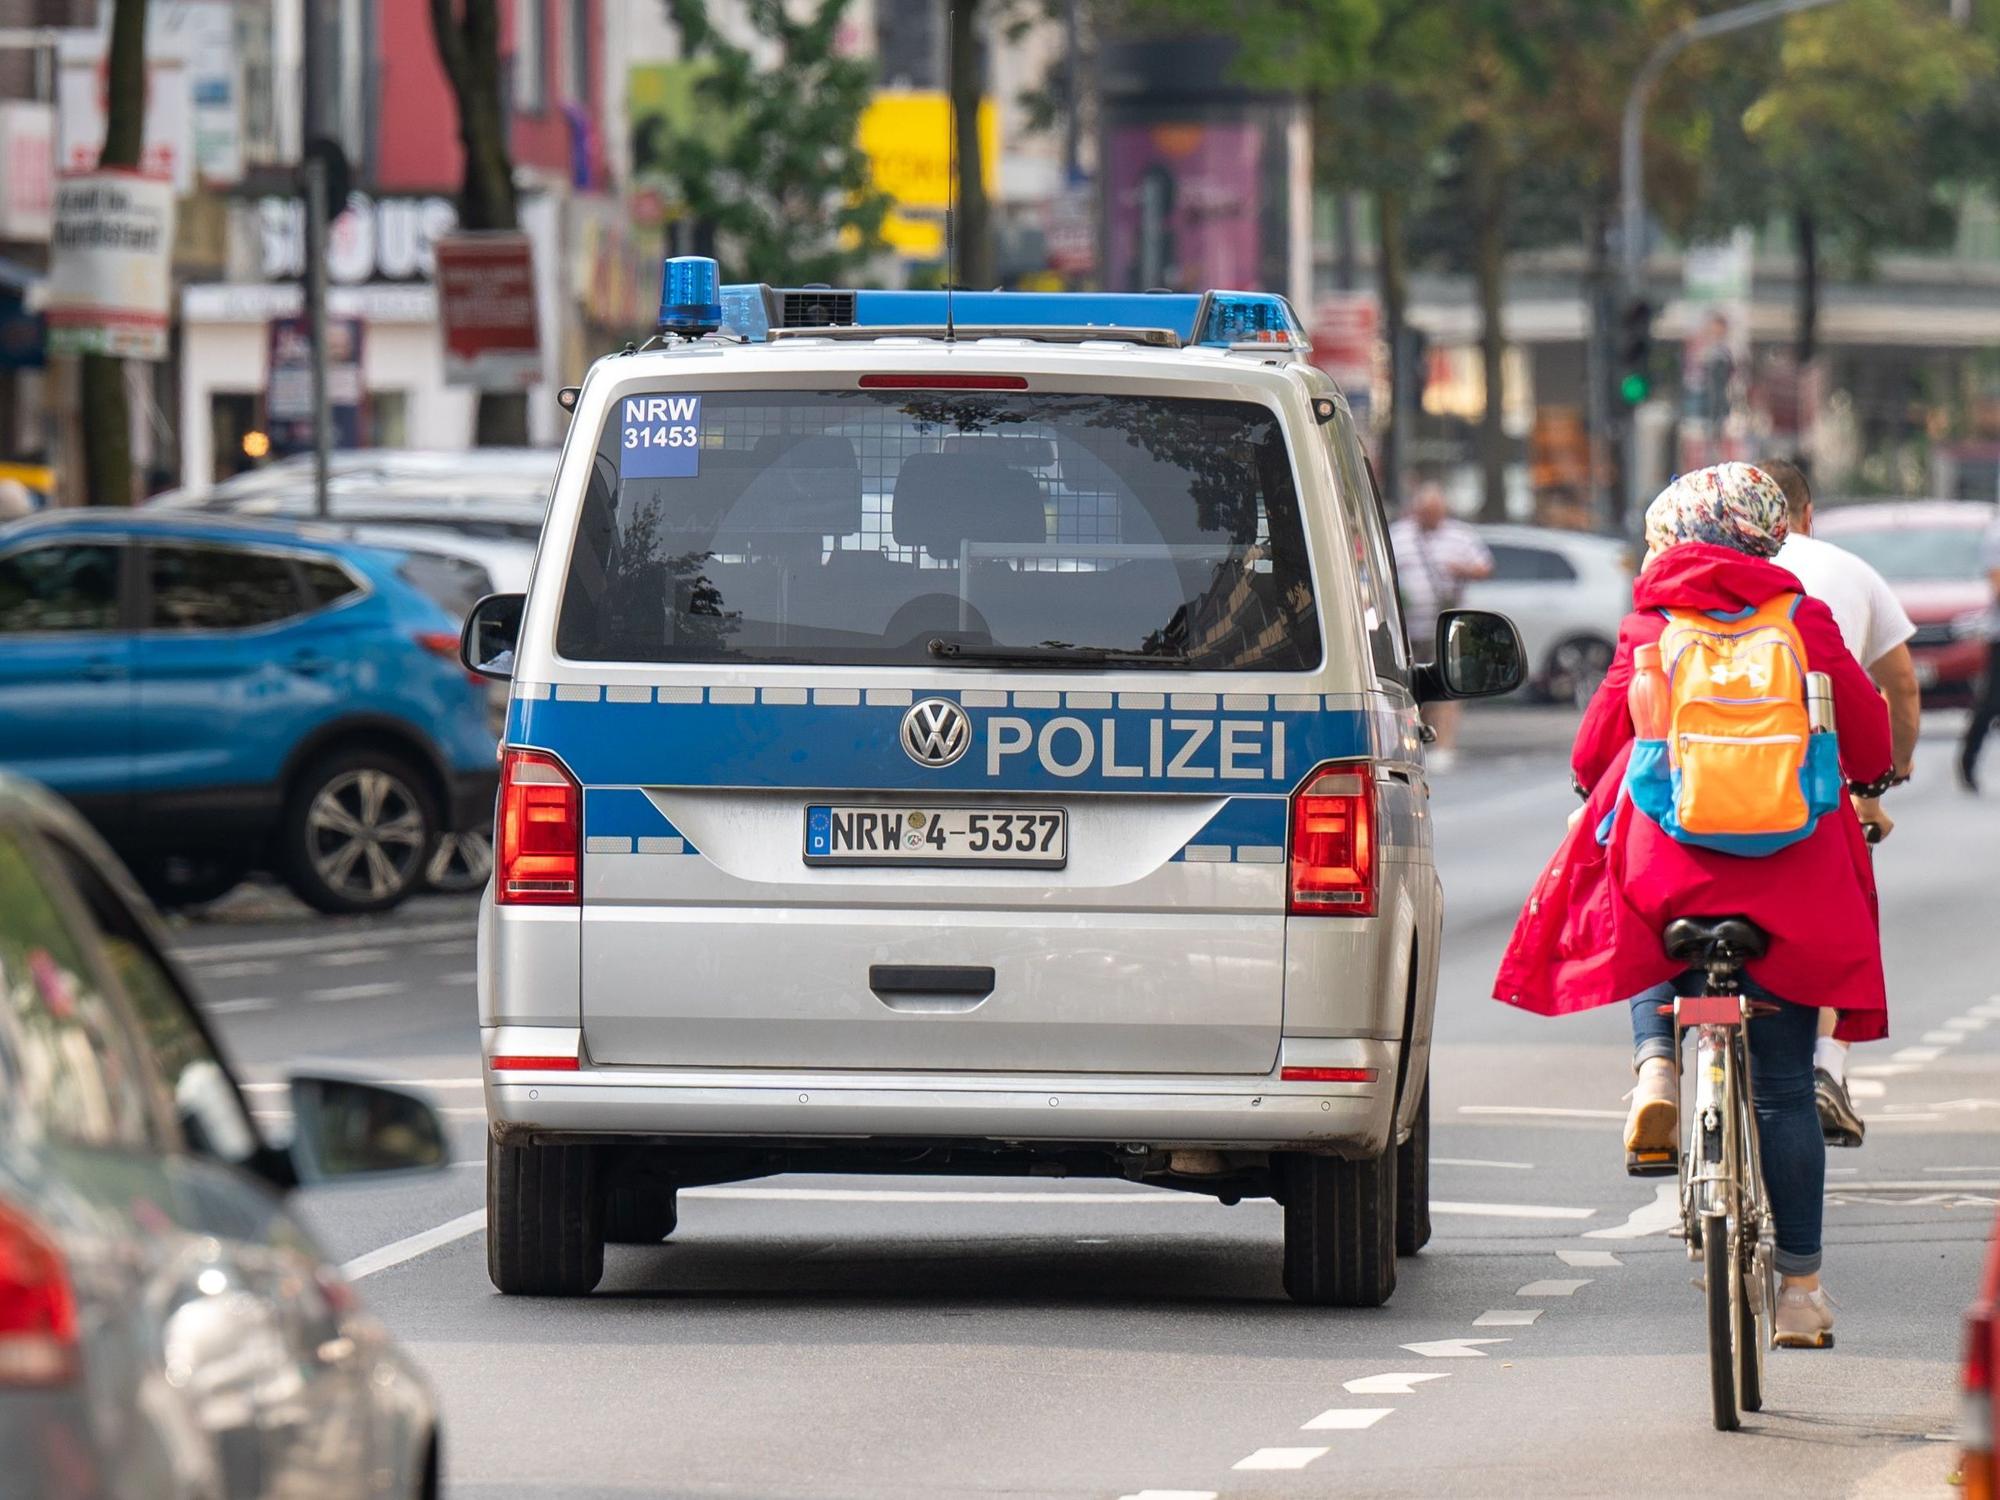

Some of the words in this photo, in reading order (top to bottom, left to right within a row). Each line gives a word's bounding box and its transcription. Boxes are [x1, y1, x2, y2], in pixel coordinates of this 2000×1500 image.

[626, 398, 697, 422] NRW
[624, 425, 698, 449] 31453
[905, 701, 968, 765] VW
[986, 716, 1286, 781] POLIZEI
[814, 836, 824, 848] D
[831, 812, 903, 851] NRW
[925, 813, 1061, 852] 4-5337
